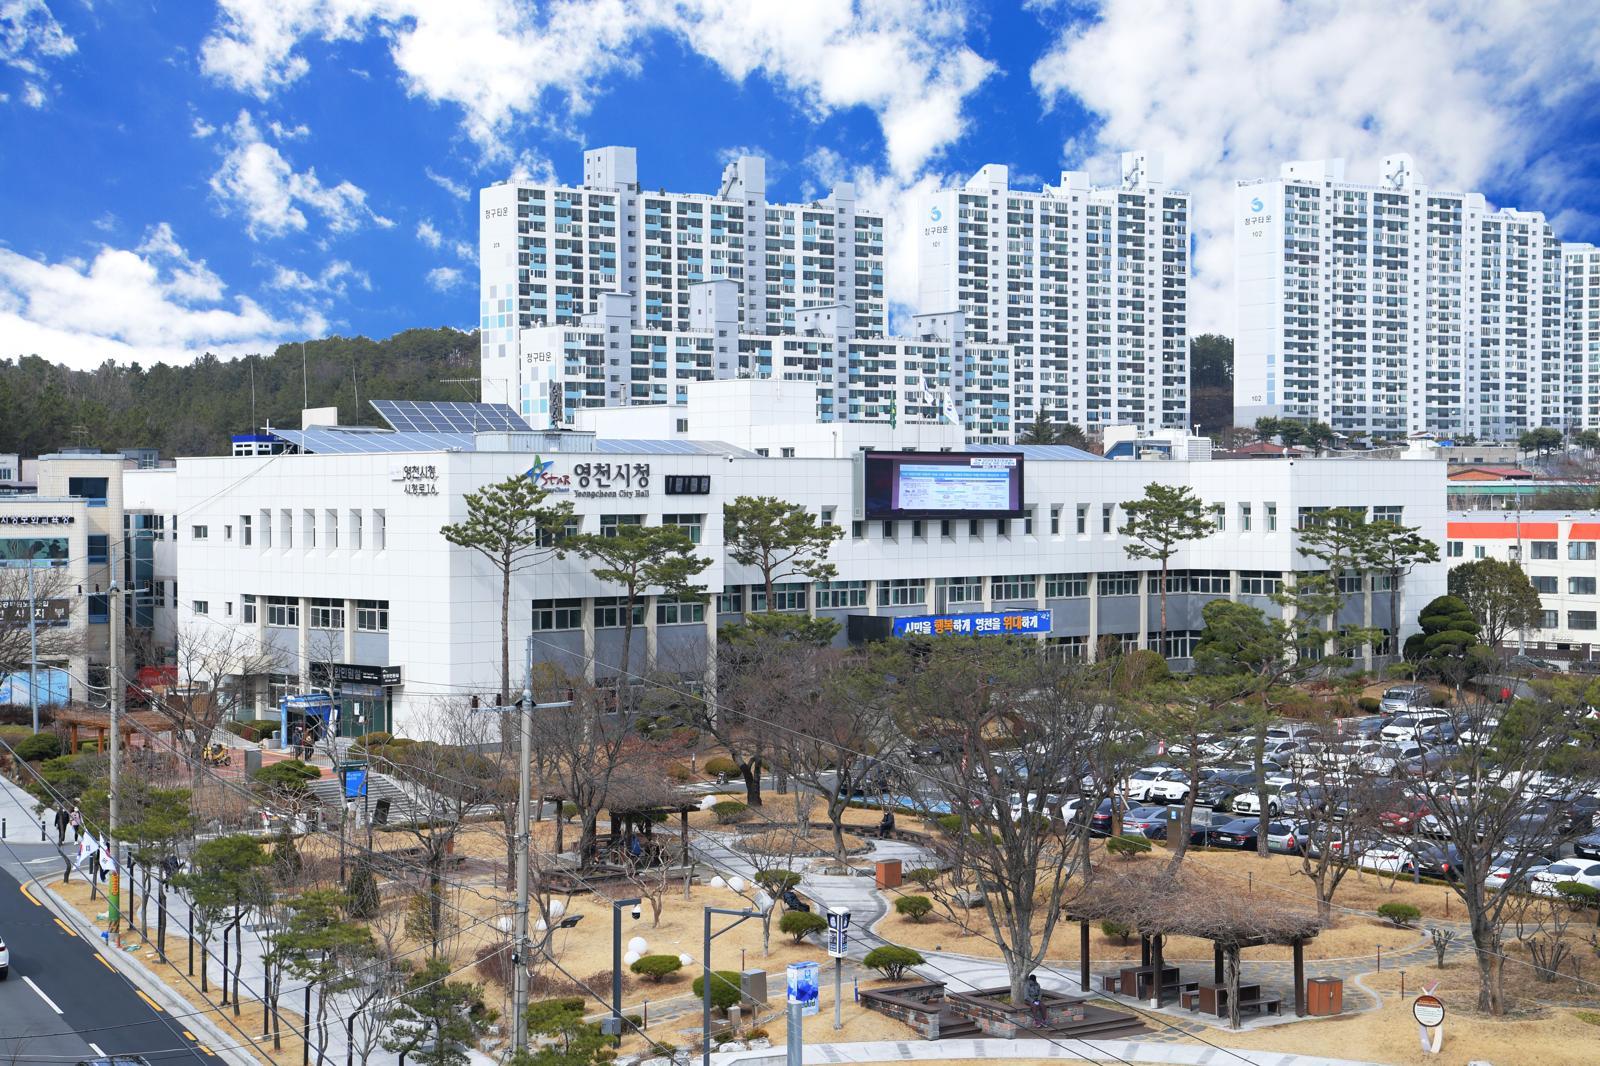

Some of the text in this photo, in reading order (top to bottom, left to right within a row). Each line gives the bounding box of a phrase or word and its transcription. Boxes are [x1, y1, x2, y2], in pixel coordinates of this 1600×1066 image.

[404, 465, 435, 480] 영천시청
[574, 463, 650, 488] 영천시청
[574, 490, 650, 499] Yeongcheon City Hall
[905, 621, 931, 634] 시민을
[934, 618, 970, 633] 행복하게
[976, 616, 1001, 630] 영천을
[1003, 614, 1038, 629] 위대하게
